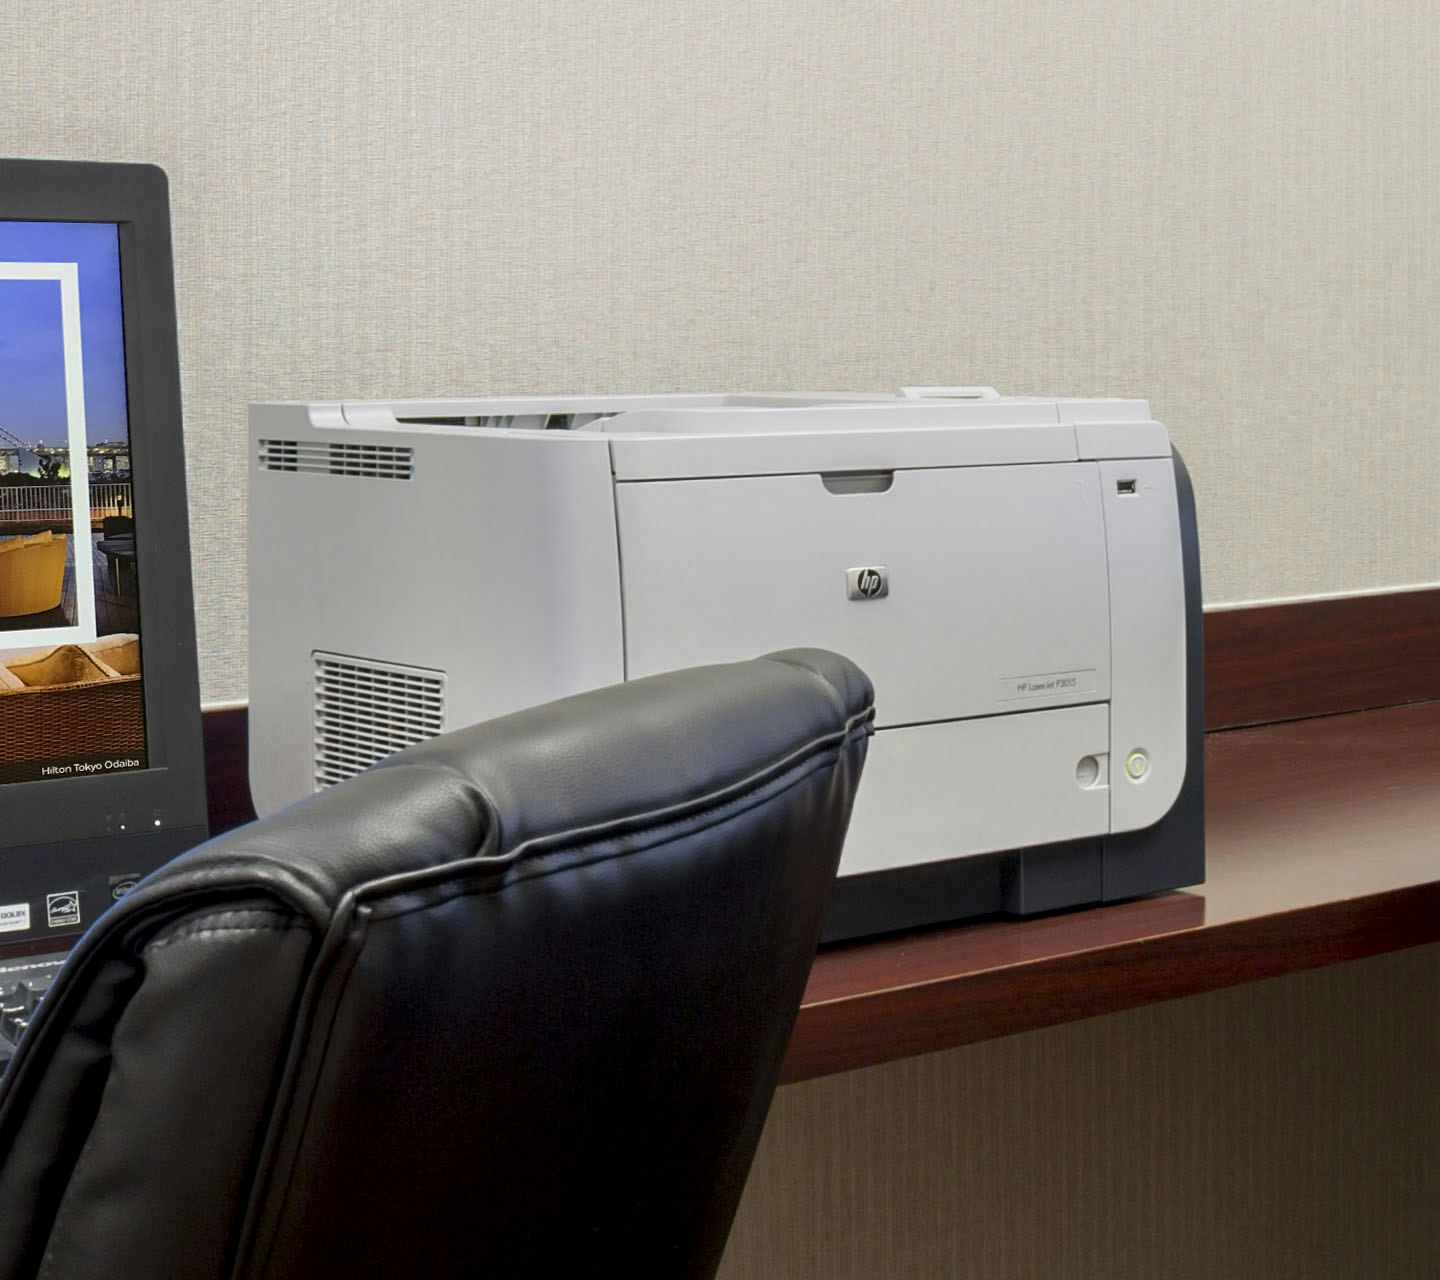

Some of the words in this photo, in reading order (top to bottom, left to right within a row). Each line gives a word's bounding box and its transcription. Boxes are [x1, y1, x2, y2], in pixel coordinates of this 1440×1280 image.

[859, 568, 880, 598] hp
[1017, 682, 1028, 692] HP
[41, 765, 72, 776] Hilton
[74, 761, 102, 773] Tokyo
[104, 758, 140, 770] Odaiba
